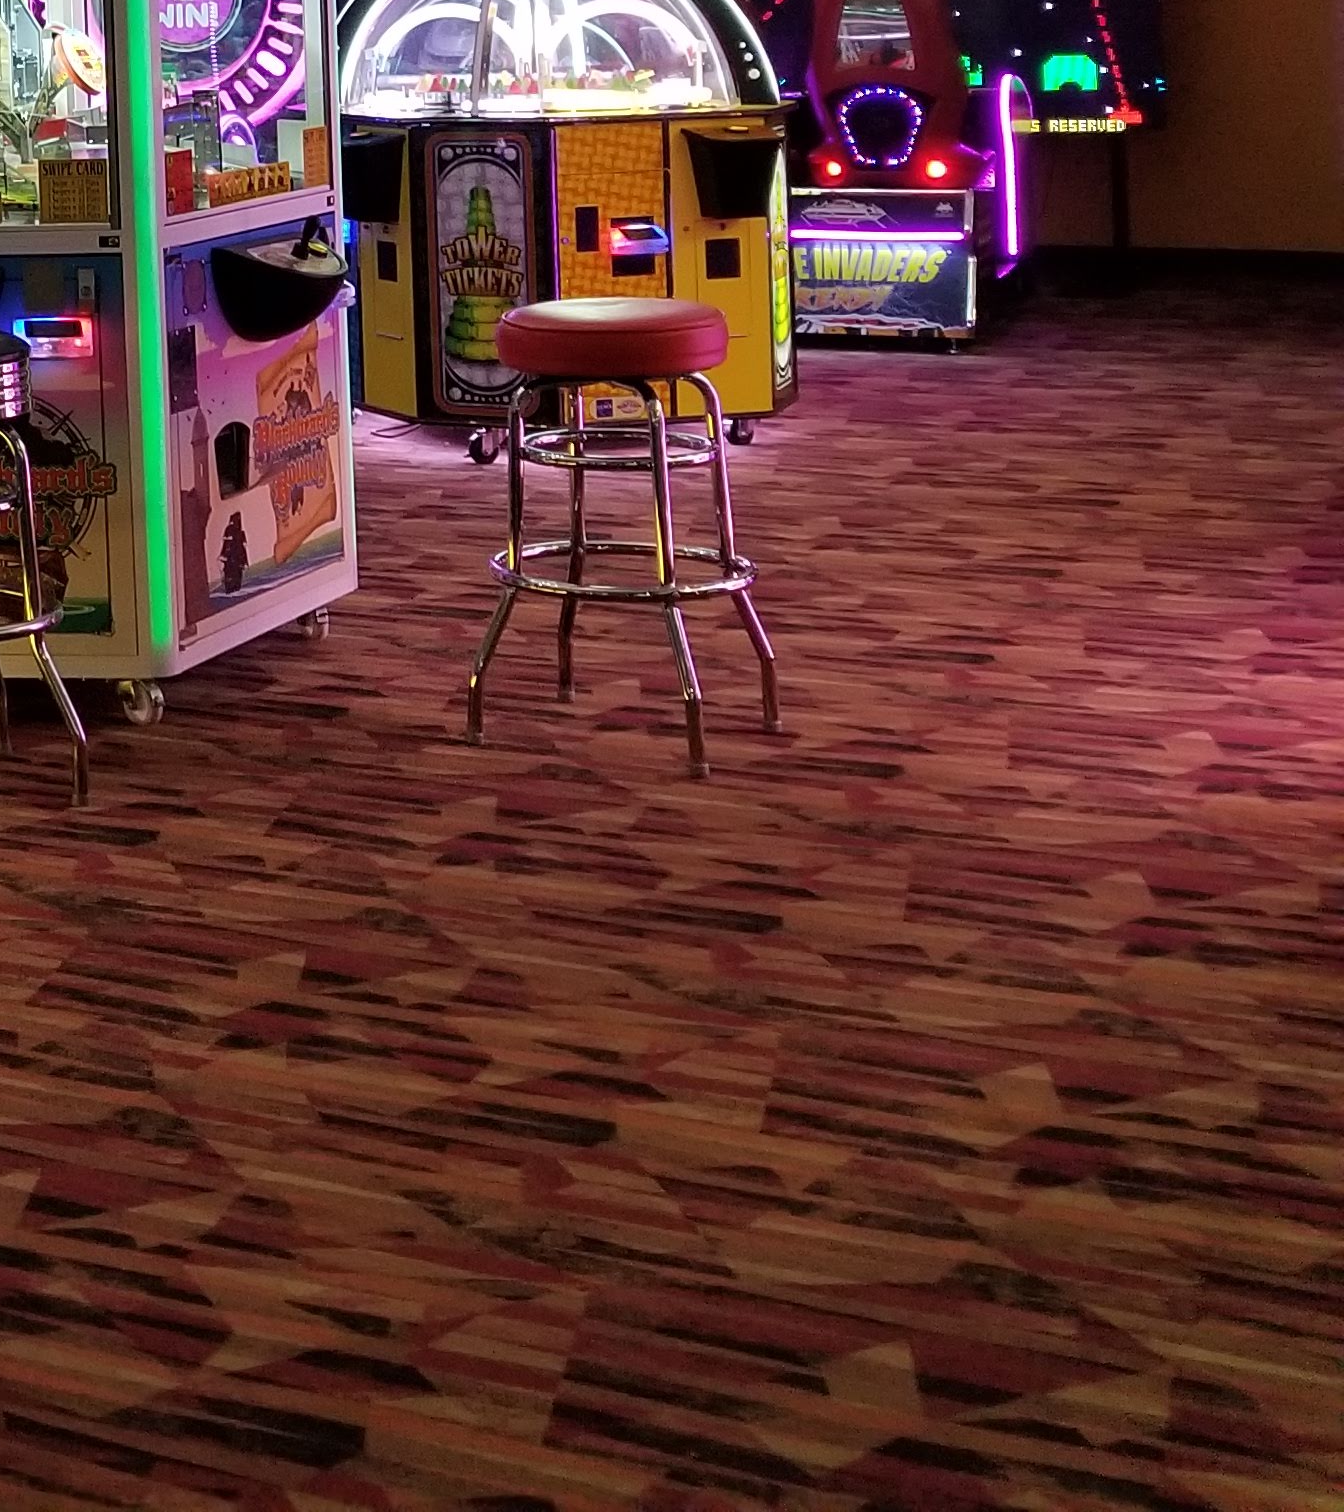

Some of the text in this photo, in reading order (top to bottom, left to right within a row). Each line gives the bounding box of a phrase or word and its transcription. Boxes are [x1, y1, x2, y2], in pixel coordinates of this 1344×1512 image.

[1049, 119, 1126, 133] RESERVED
[42, 161, 104, 177] SWIPE CARD
[441, 225, 521, 265] TOWER
[814, 244, 949, 283] INVADERS
[440, 267, 524, 297] TICKETS
